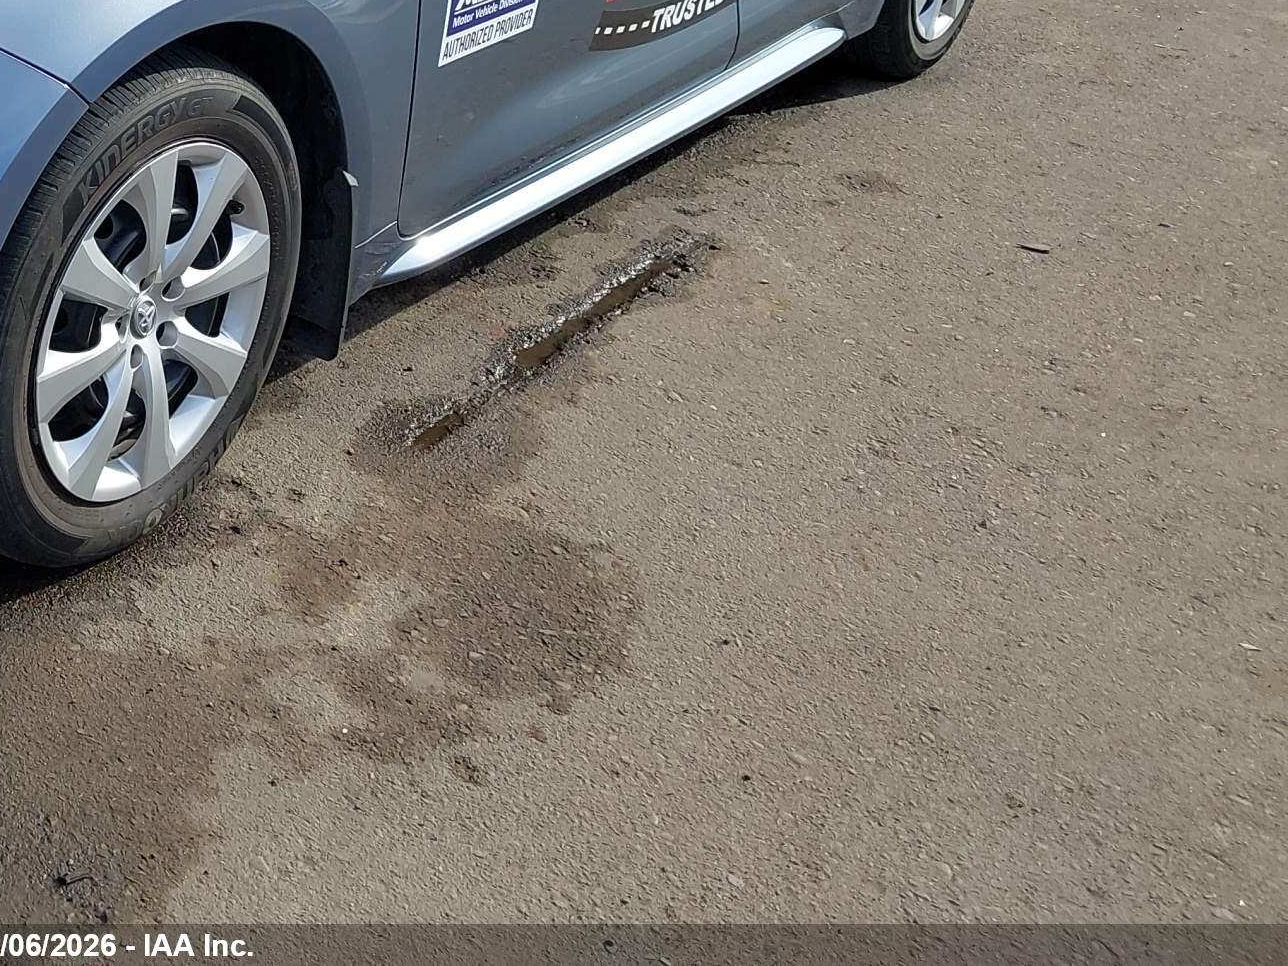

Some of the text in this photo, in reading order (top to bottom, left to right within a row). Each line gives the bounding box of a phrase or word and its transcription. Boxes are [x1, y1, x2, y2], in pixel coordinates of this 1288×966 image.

[442, 7, 534, 61] AUTHORIZED PROVIDER
[452, 13, 475, 29] Motor
[475, 1, 499, 20] Vehicle
[78, 96, 187, 206] KINERGY
